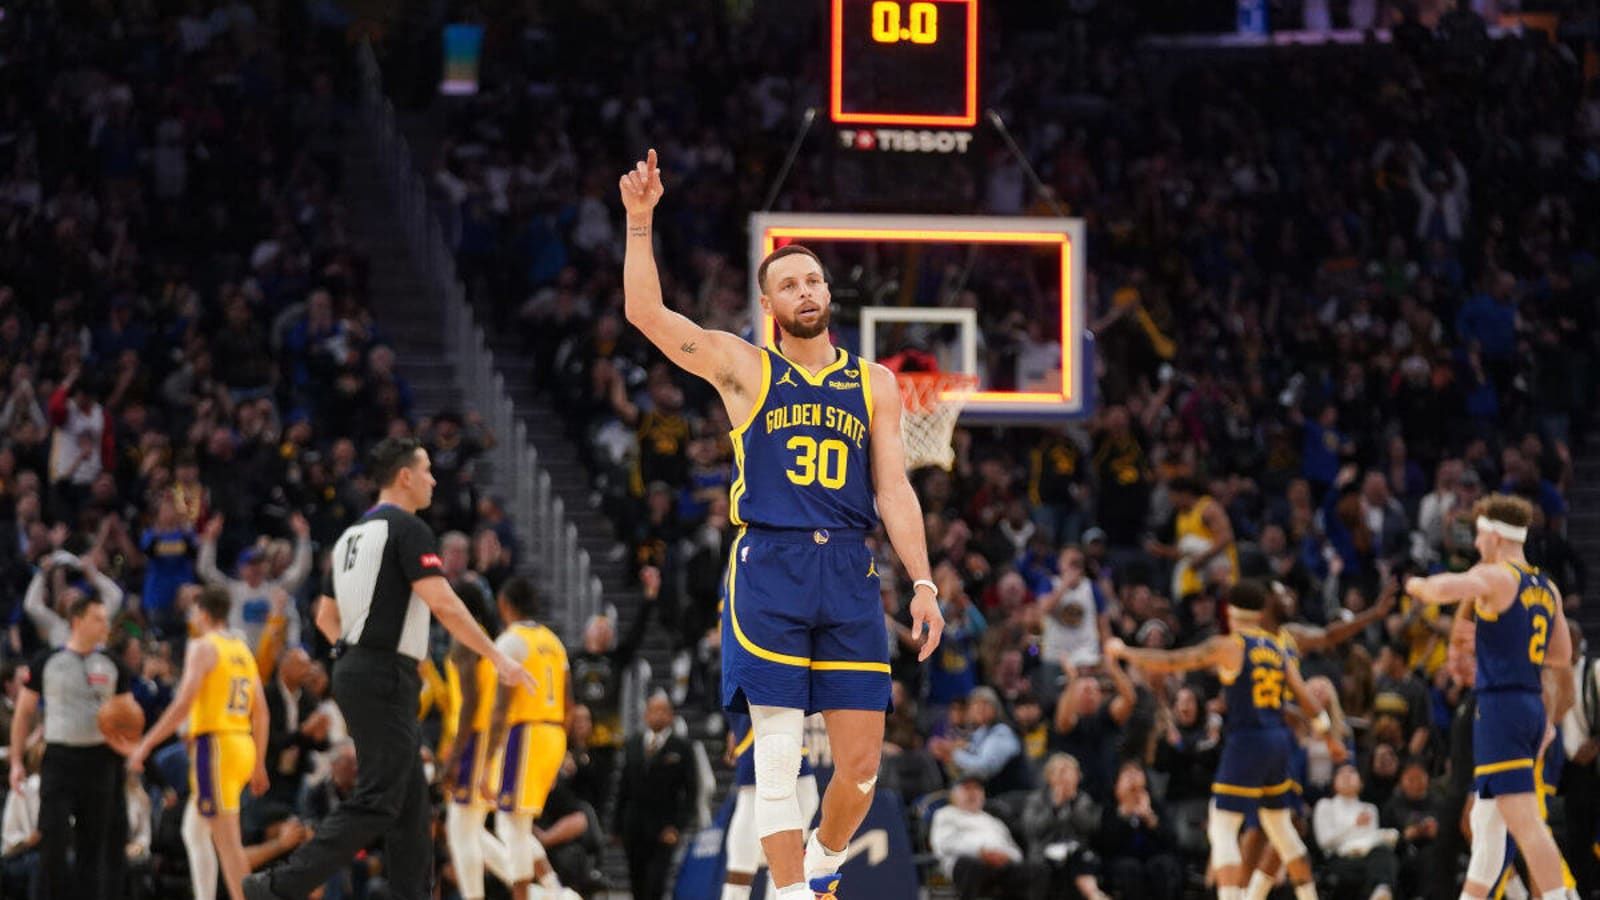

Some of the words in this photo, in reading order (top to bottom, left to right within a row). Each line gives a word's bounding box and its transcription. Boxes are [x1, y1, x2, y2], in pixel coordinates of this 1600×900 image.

[872, 1, 938, 44] 0.0
[875, 129, 973, 153] TISSOT
[766, 404, 821, 434] GOLDEN
[825, 405, 866, 449] STATE
[786, 436, 849, 490] 30
[343, 533, 362, 573] 15
[1528, 613, 1548, 665] 2
[228, 677, 252, 715] 15
[545, 667, 556, 706] 1
